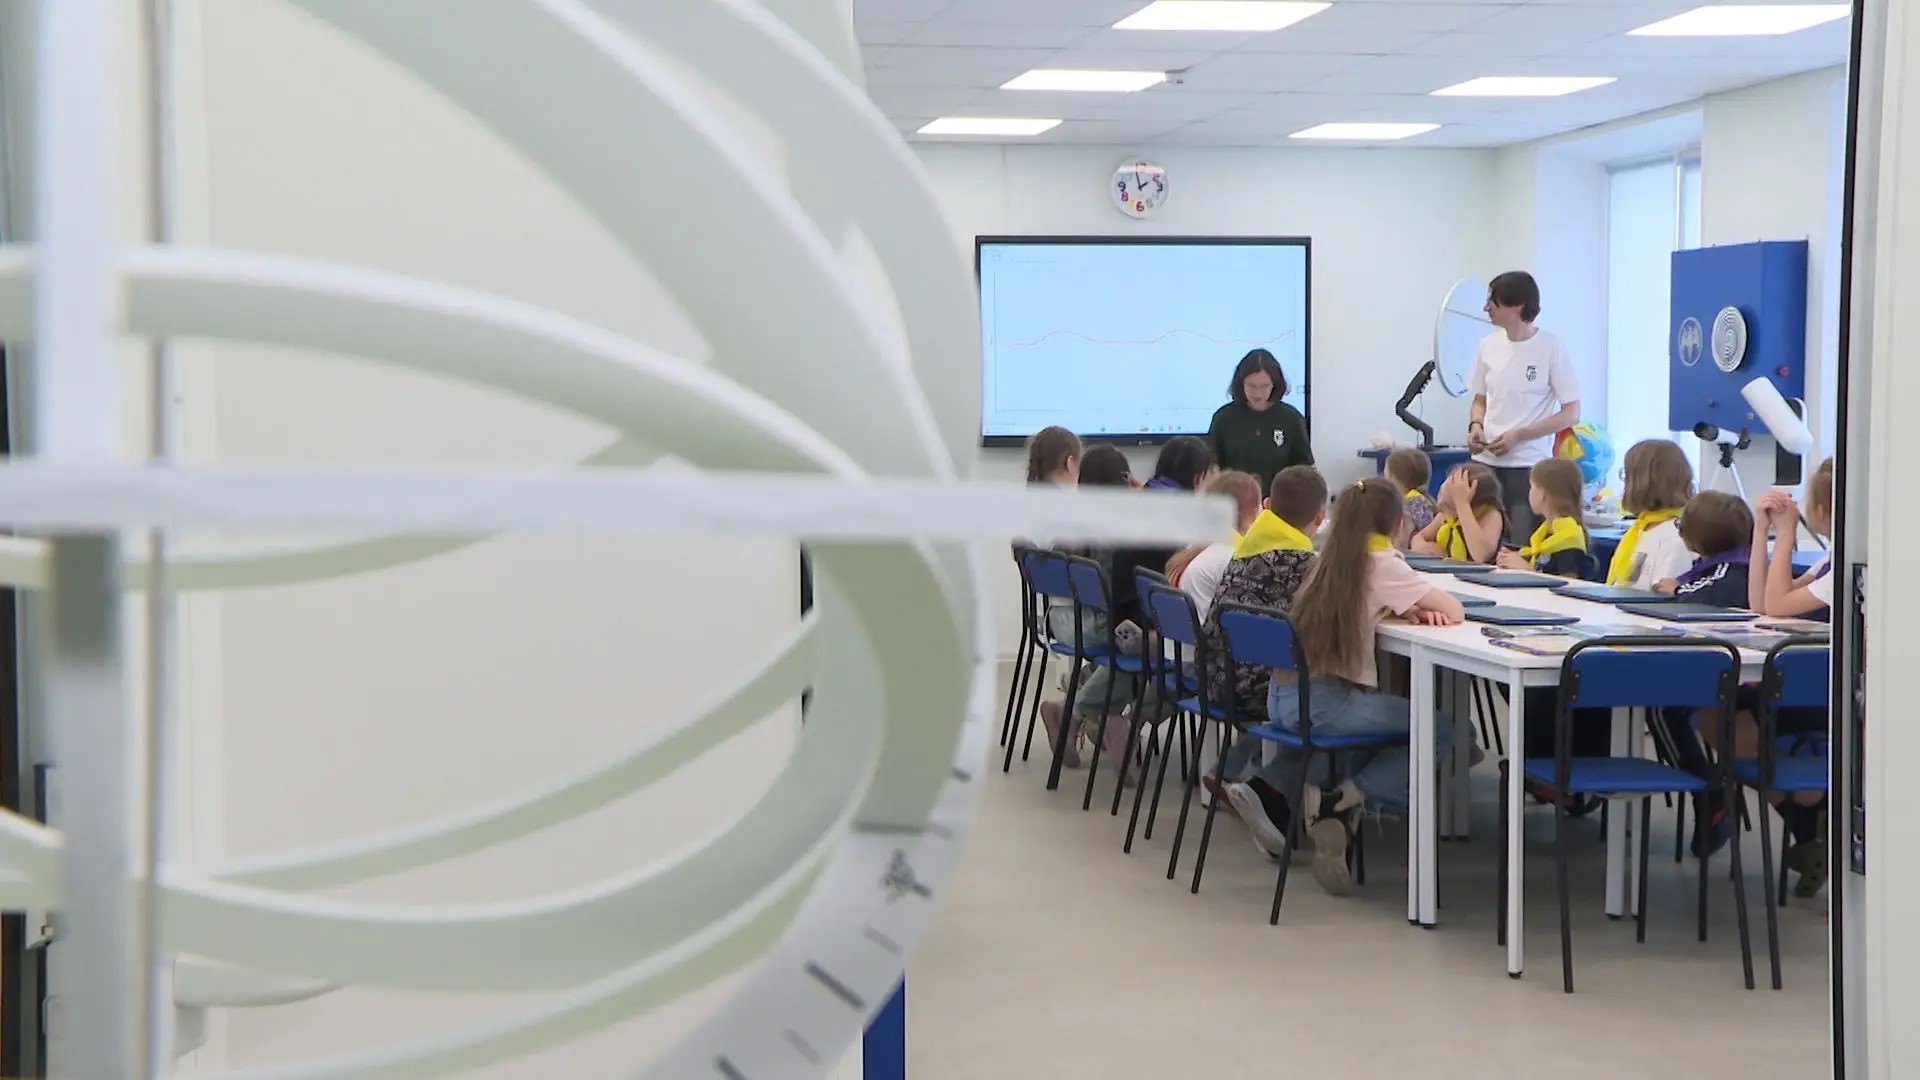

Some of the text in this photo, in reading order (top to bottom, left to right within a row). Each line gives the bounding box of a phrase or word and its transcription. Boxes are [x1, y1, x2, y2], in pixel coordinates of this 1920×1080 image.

[1118, 181, 1126, 192] 9
[1121, 191, 1128, 202] 8
[1136, 201, 1144, 212] 6
